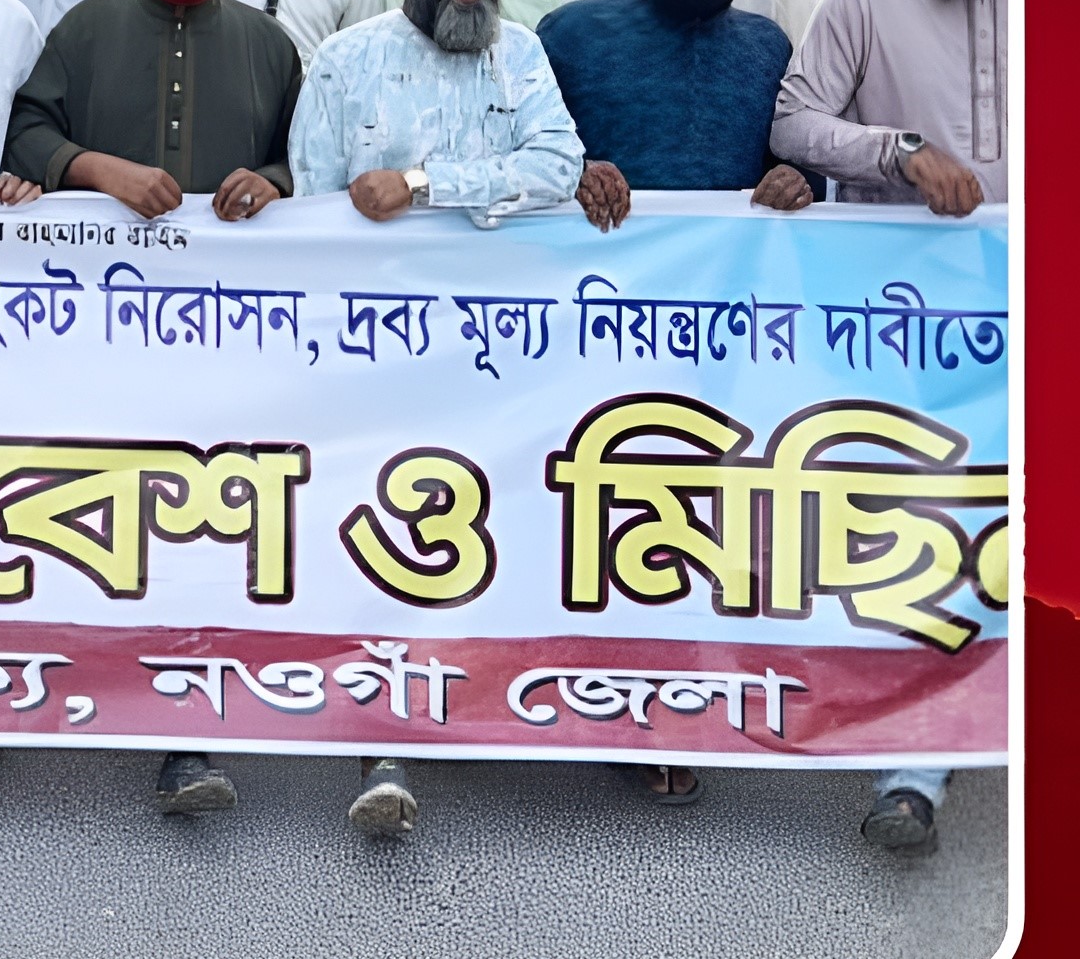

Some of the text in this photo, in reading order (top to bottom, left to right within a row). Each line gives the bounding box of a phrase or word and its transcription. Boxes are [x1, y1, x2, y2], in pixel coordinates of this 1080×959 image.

[98, 261, 320, 366] নিরোসন,
[337, 290, 439, 362] দ্রব্য
[451, 293, 559, 380] মূল্য
[572, 273, 806, 366] নিয়ন্ত্রণের
[819, 281, 1008, 371] দাবীতে
[338, 446, 498, 610] ও
[137, 640, 469, 726] নওগাঁ
[506, 667, 809, 738] জেলা
